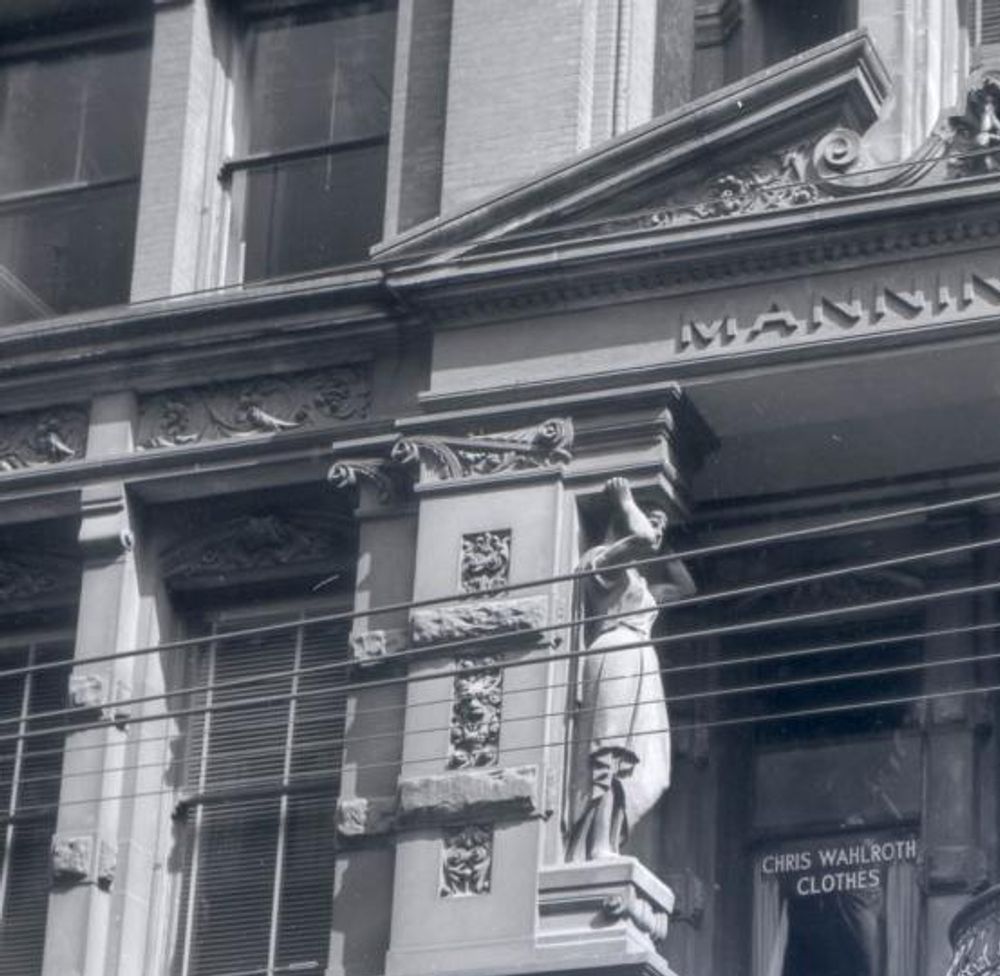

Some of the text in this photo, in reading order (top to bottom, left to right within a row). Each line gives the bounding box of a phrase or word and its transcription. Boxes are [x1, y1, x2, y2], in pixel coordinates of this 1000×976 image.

[762, 840, 917, 874] CHRIS WAHLROTH
[797, 869, 880, 896] CLOTHES
